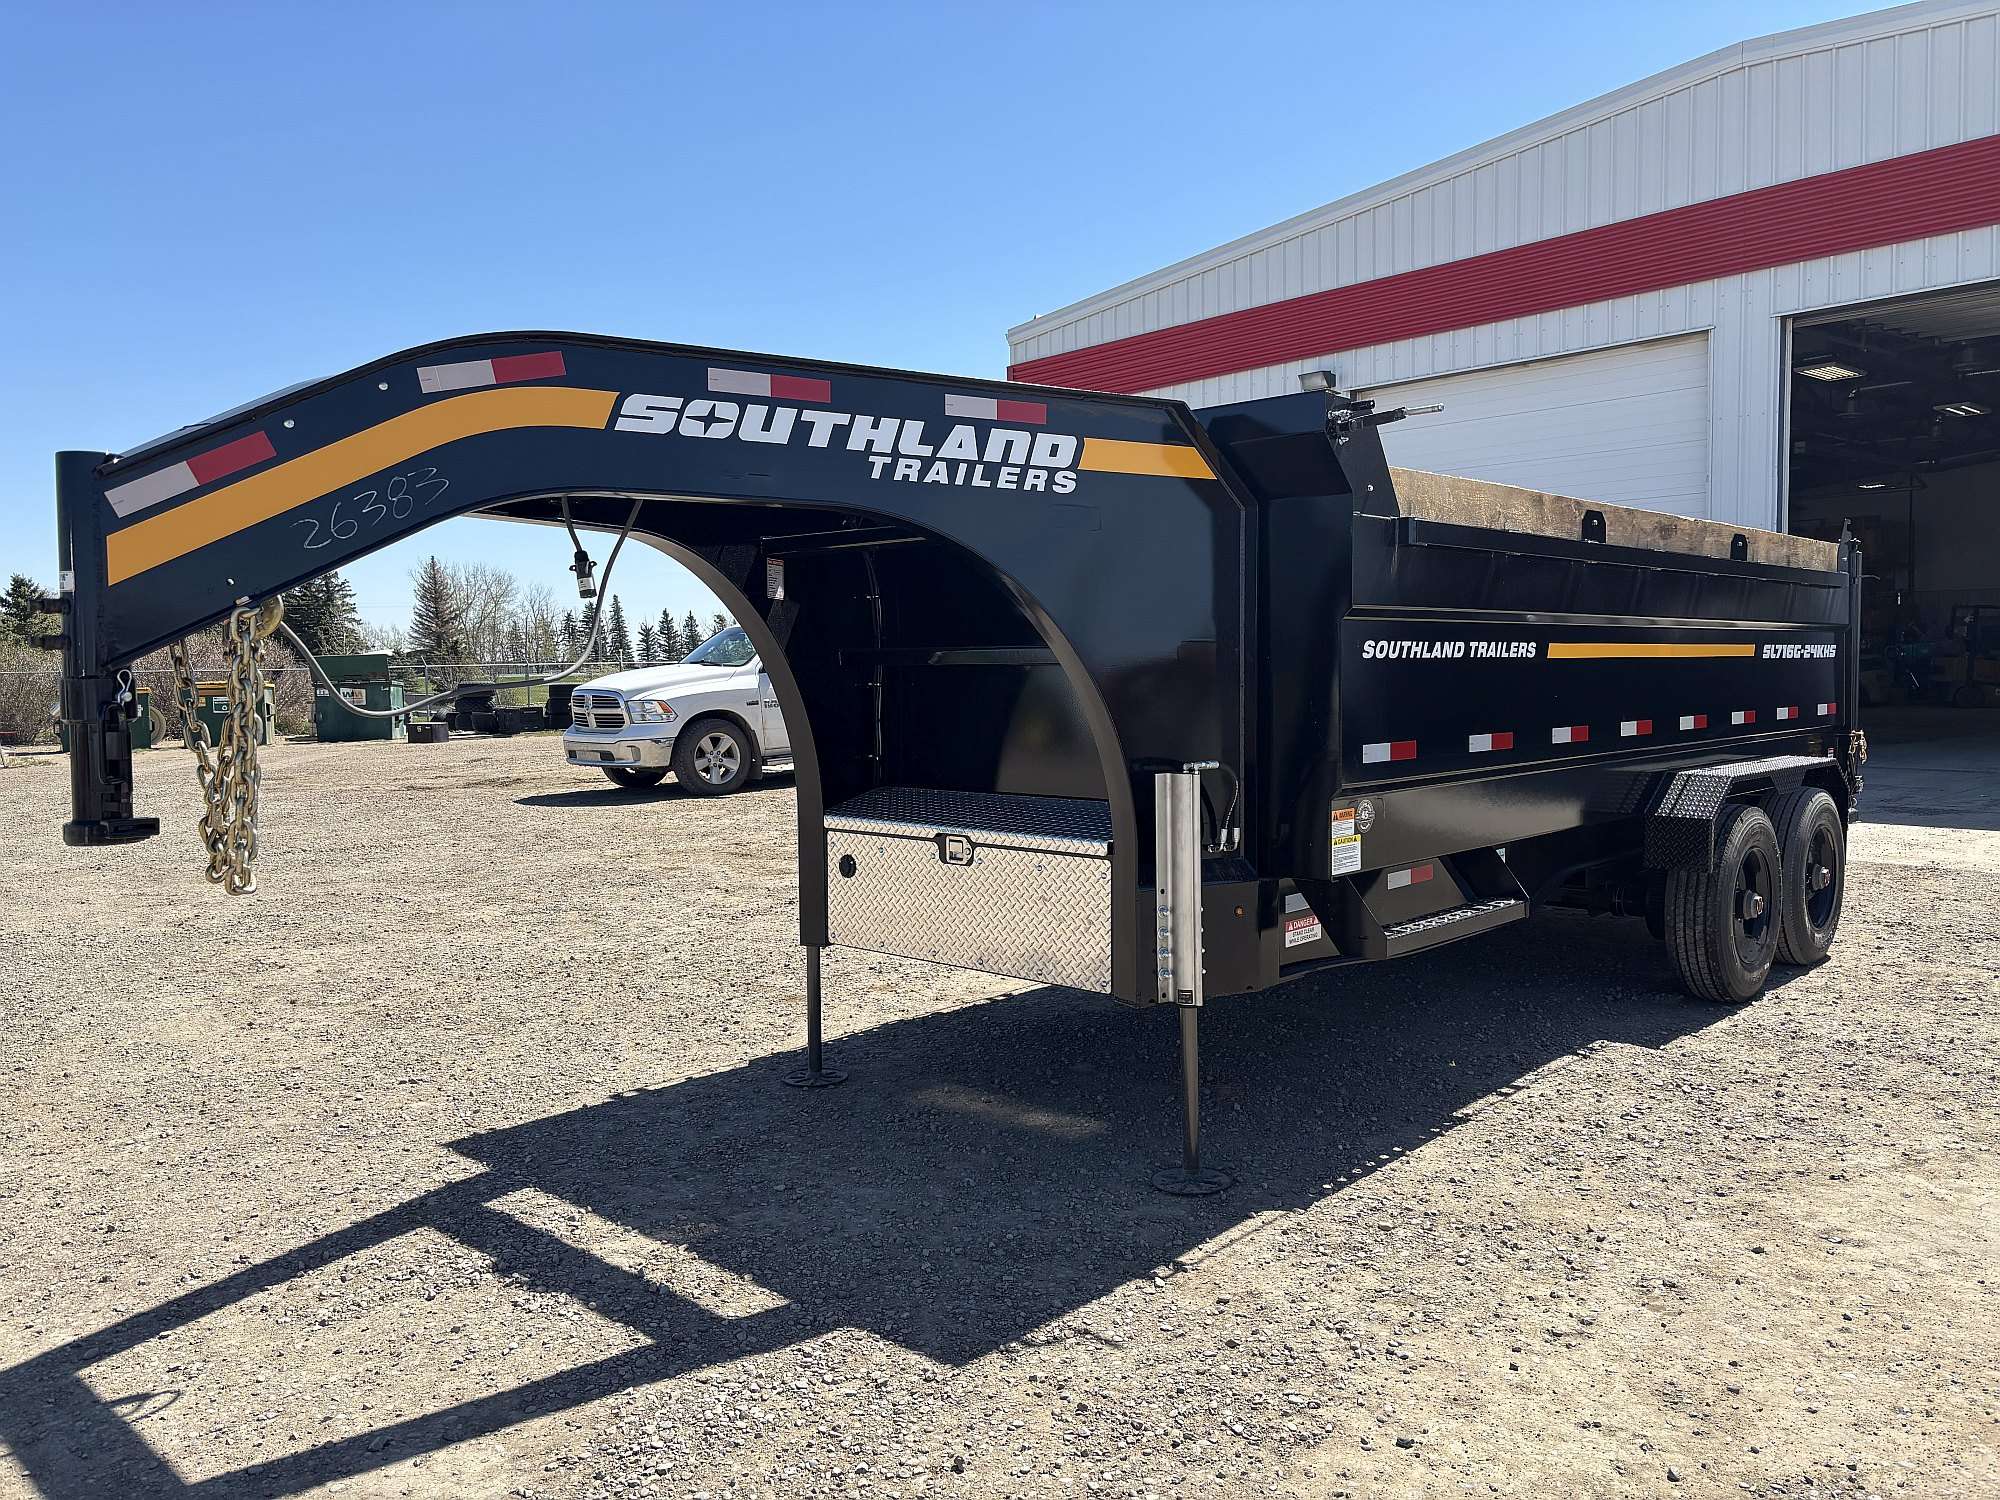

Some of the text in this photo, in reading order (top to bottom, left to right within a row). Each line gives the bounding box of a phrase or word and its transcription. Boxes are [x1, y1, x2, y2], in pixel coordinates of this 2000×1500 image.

[615, 393, 1078, 468] SOUTHLAND
[868, 455, 1078, 494] TRAILERS
[289, 467, 450, 549] 26383
[1362, 639, 1537, 659] SOUTHLAND TRAILERS
[1762, 644, 1837, 659] SL716G-24KHS
[1337, 836, 1354, 845] CAUTION
[1293, 917, 1313, 929] DANGER
